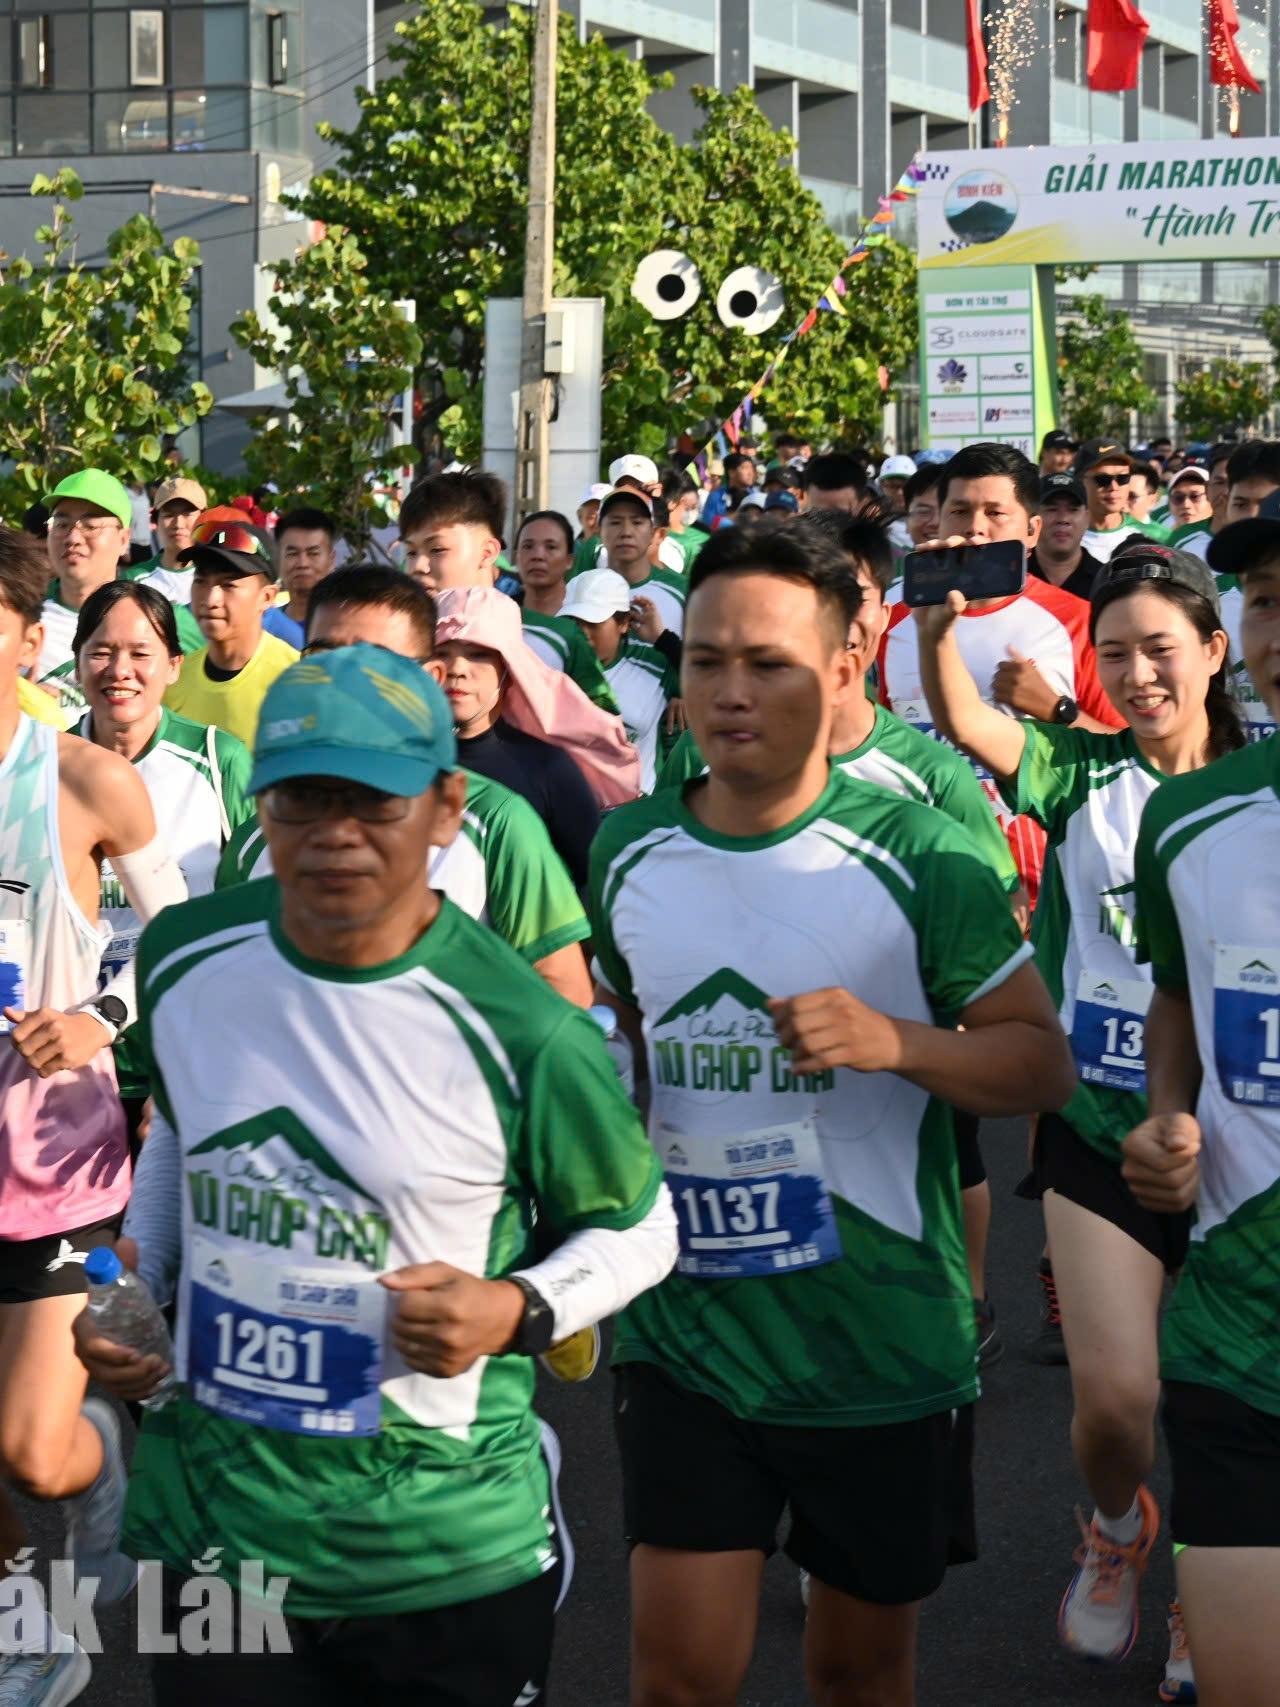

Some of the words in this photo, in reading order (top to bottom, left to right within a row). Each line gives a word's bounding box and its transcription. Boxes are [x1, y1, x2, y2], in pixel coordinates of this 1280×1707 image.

[1044, 154, 1109, 194] GIẢI
[692, 1040, 763, 1093] CHÓP
[682, 1181, 781, 1235] 1137
[215, 1312, 324, 1384] 1261
